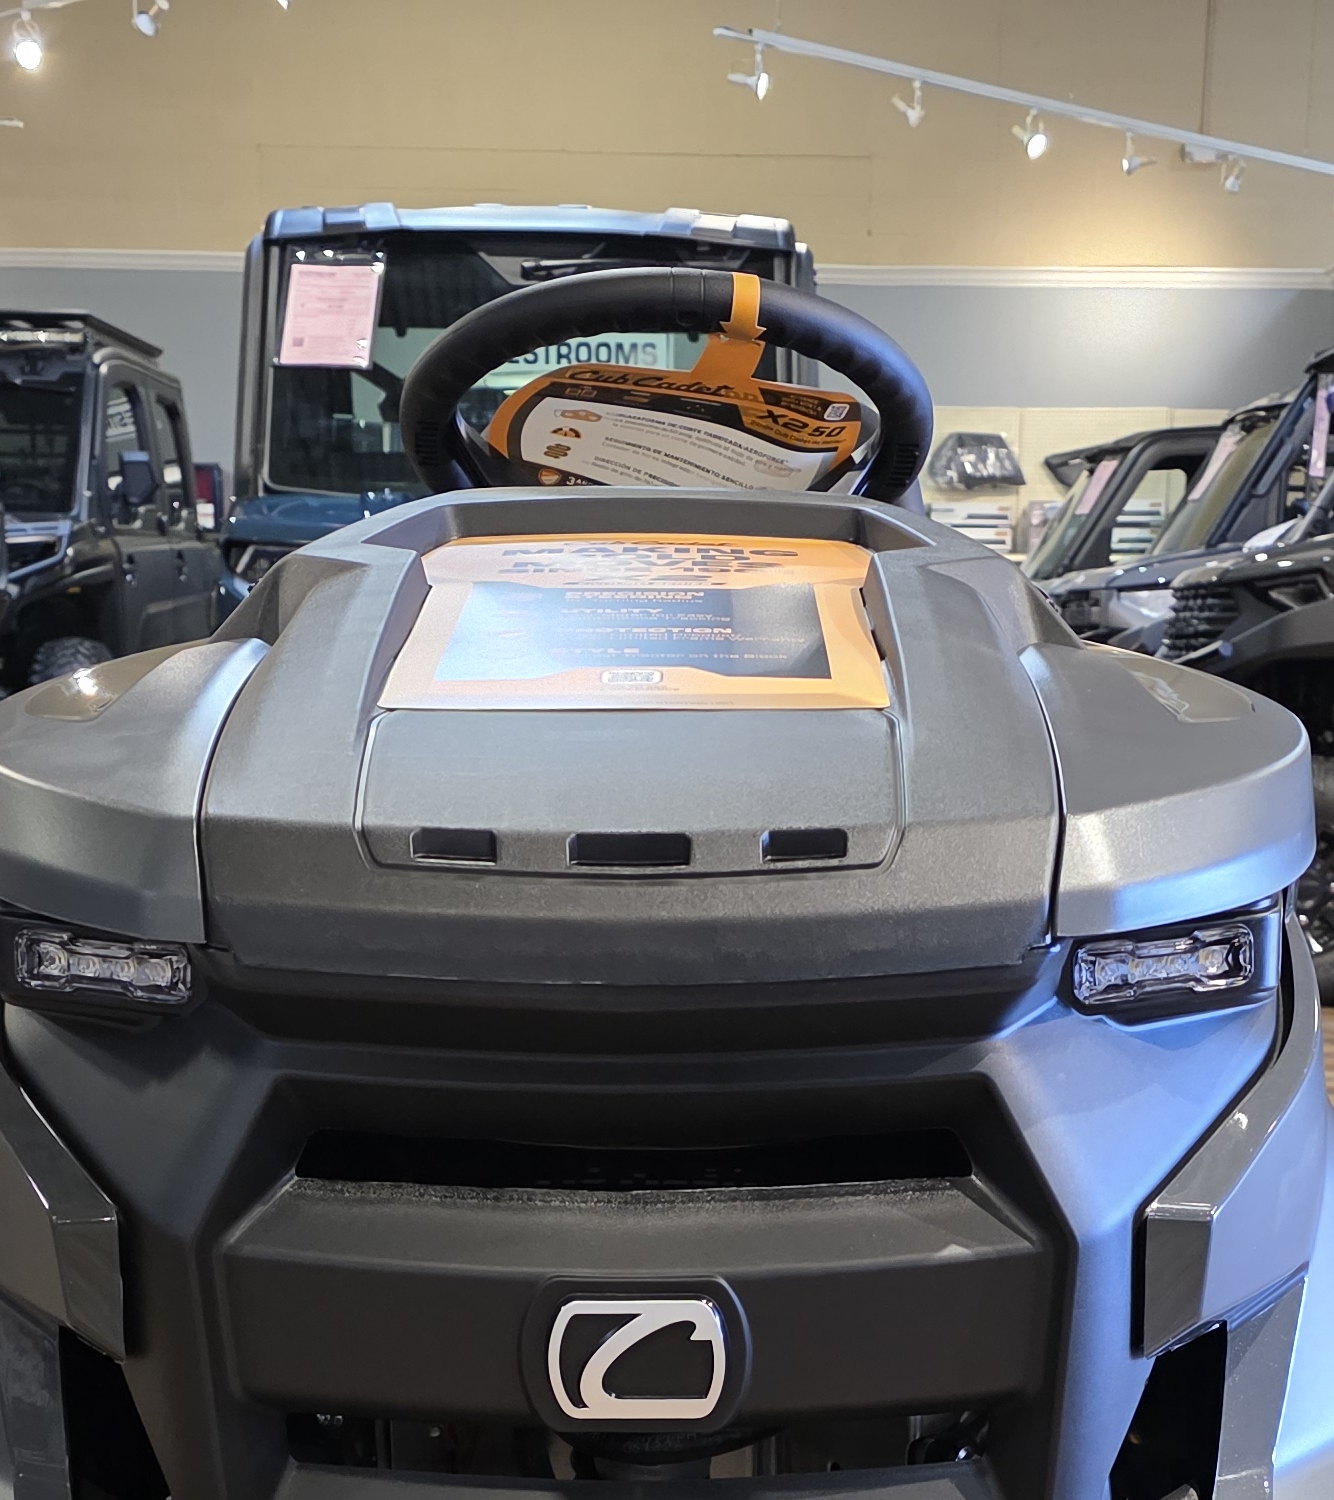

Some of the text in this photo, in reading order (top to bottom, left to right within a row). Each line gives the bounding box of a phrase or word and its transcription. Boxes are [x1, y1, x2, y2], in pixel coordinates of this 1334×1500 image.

[567, 370, 735, 397] Cub Cadet
[756, 409, 809, 433] X2
[808, 425, 846, 438] 50
[593, 455, 632, 471] DIRECCIÓN
[632, 466, 642, 475] DE
[566, 475, 576, 486] 3
[501, 546, 799, 557] MAKING
